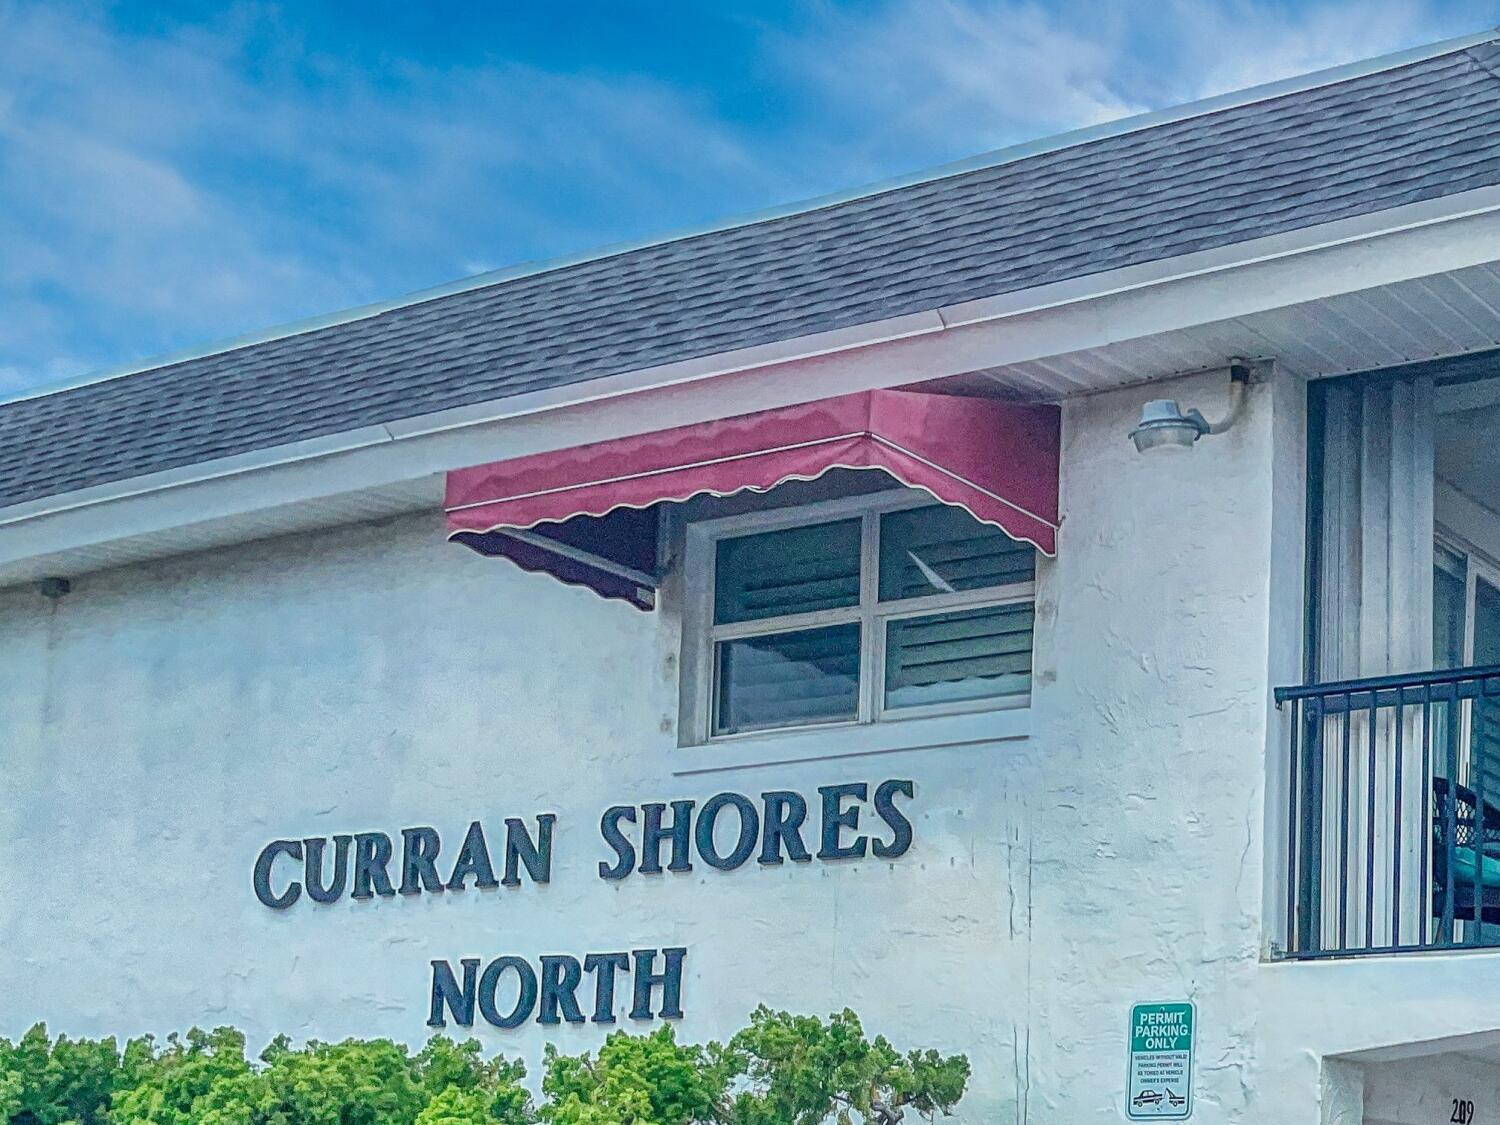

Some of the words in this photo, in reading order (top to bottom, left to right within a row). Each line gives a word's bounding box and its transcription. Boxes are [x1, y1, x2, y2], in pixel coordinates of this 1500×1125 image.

[253, 812, 556, 909] CURRAN
[598, 778, 914, 881] SHORES
[427, 946, 687, 1029] NORTH
[1140, 1011, 1185, 1026] PERMIT
[1135, 1024, 1188, 1038] PARKING
[1145, 1037, 1177, 1050] ONLY
[1450, 1098, 1474, 1125] 209
